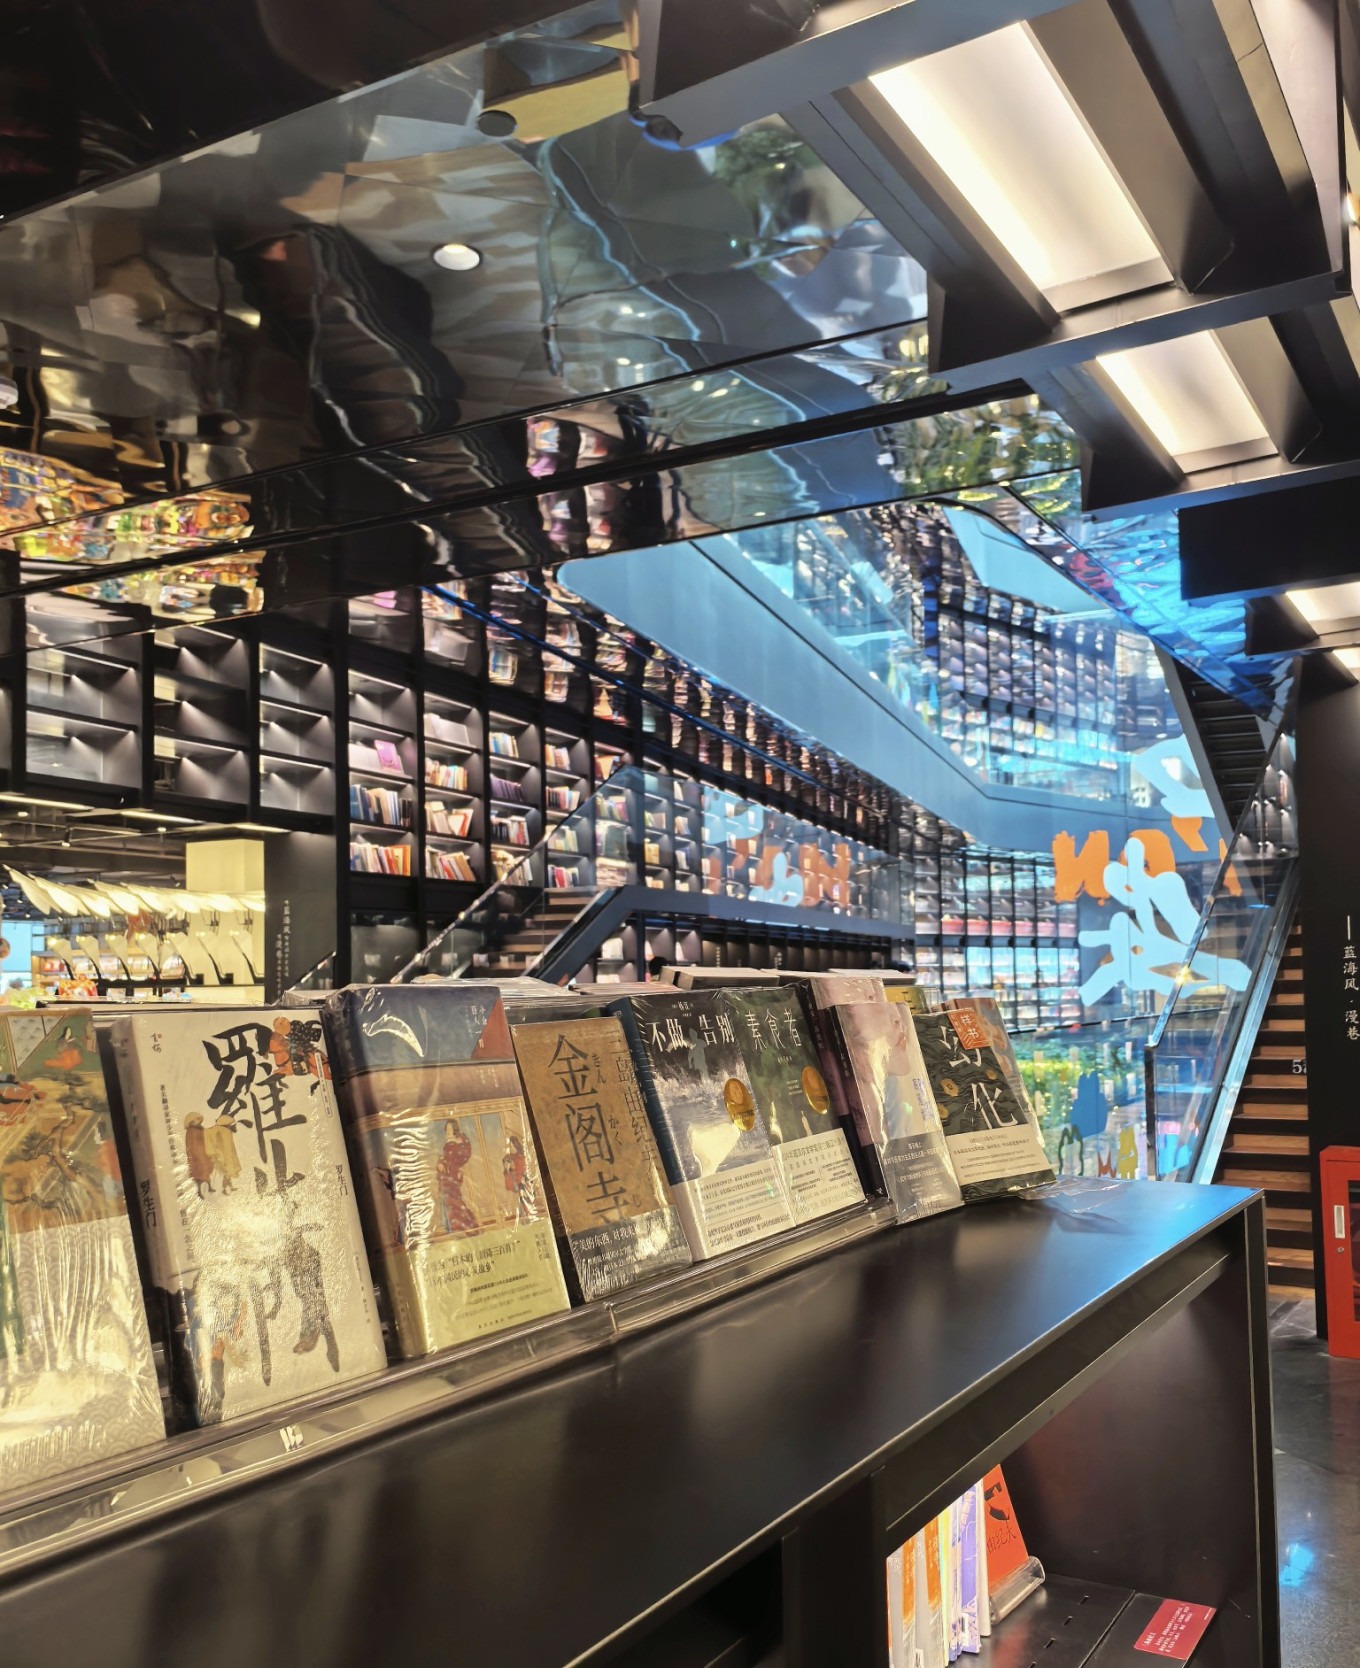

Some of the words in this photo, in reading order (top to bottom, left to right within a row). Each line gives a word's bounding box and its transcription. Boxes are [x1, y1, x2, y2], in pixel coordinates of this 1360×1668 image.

[646, 1012, 735, 1053] 不做告别
[745, 1008, 802, 1050] 素食者
[548, 1034, 631, 1224] 金阁寺
[335, 1164, 349, 1197] 罗生门
[139, 1179, 157, 1229] 罗生门
